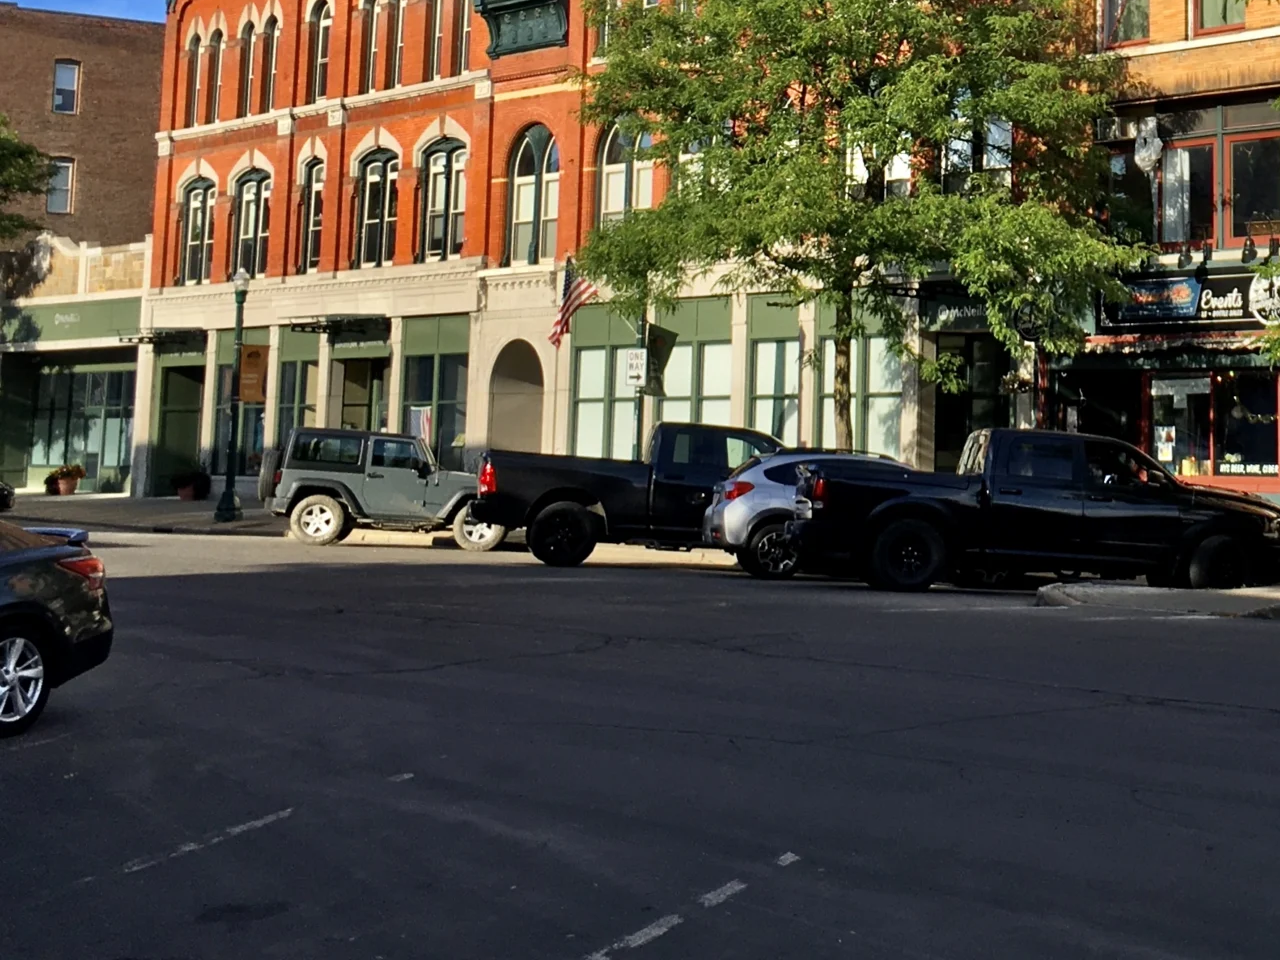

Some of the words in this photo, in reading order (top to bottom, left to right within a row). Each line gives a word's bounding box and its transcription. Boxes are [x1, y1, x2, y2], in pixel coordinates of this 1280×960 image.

[1201, 287, 1243, 309] Events
[629, 352, 644, 361] ONE
[629, 363, 644, 371] WAY
